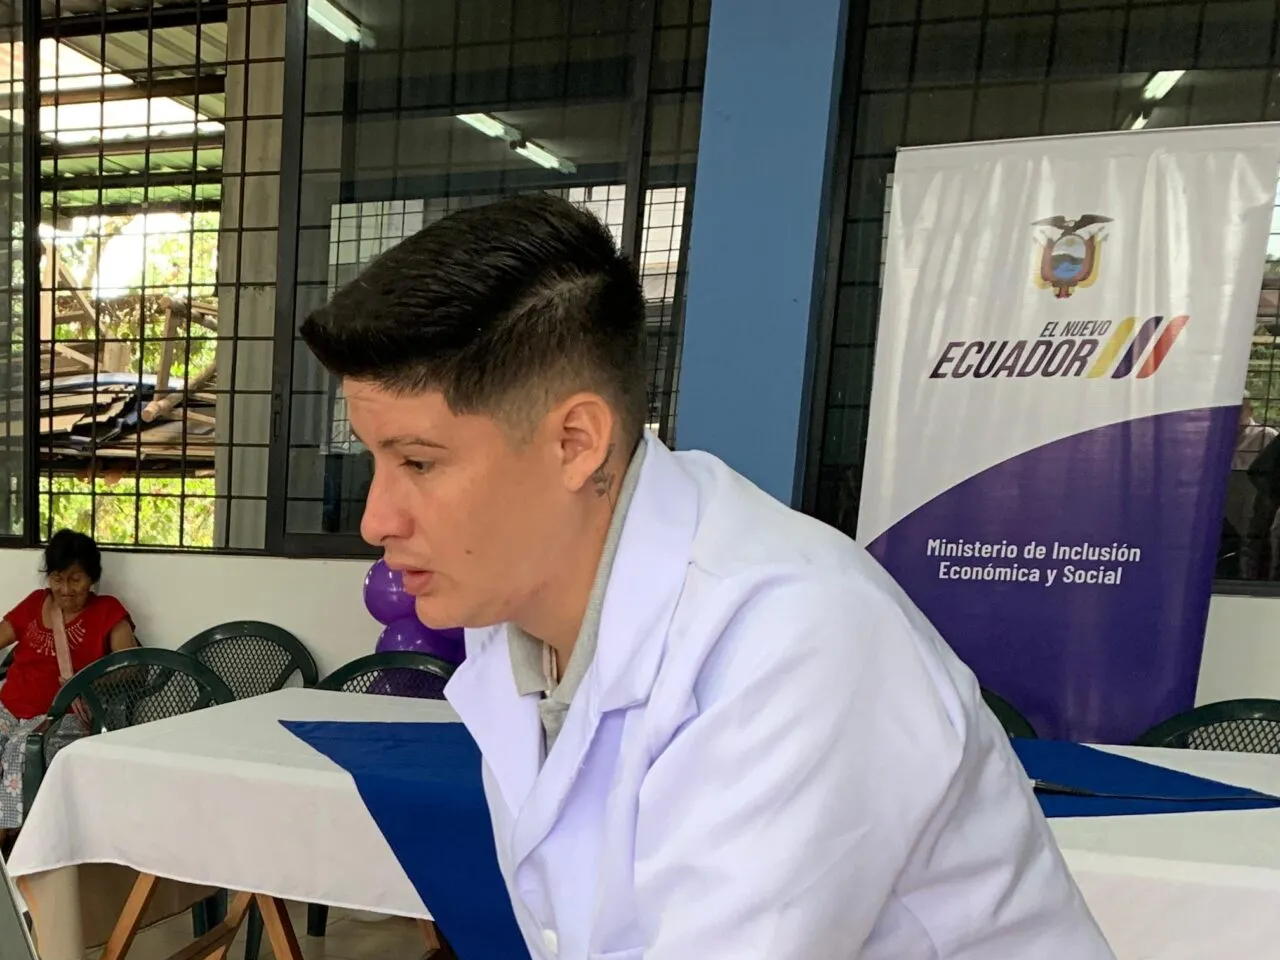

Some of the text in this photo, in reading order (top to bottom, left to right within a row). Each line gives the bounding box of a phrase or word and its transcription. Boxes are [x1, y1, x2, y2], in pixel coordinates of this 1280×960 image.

[1039, 319, 1112, 338] EL NUEVO
[928, 338, 1100, 379] ECUADOR
[926, 538, 1141, 562] Ministerio de Inclusión
[938, 561, 1122, 587] Económica y Social
